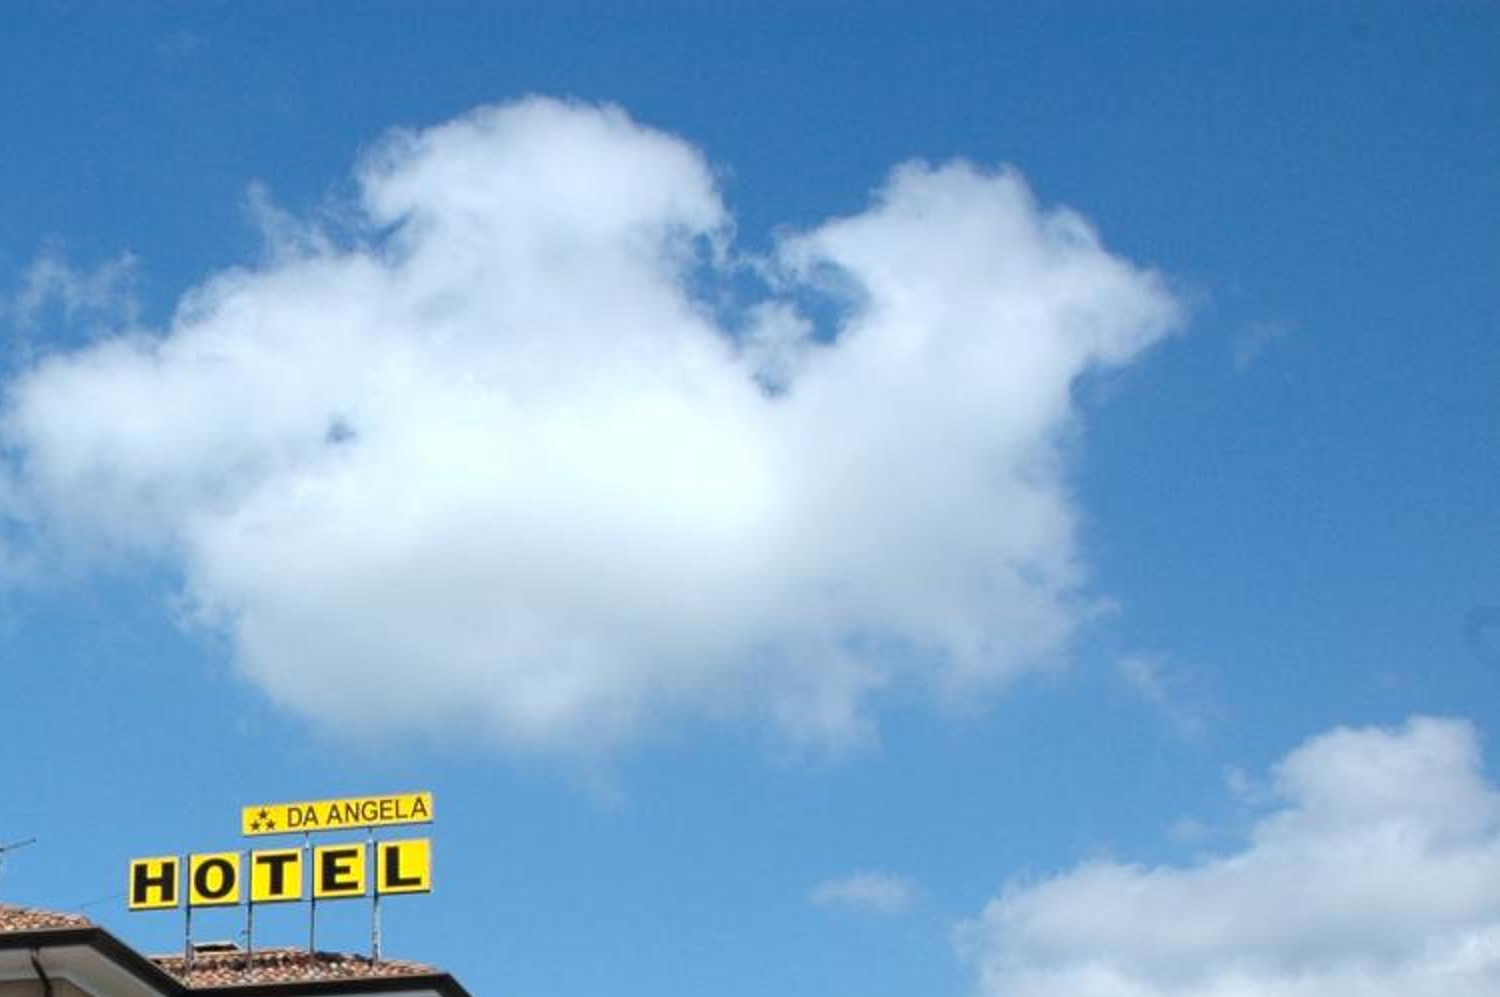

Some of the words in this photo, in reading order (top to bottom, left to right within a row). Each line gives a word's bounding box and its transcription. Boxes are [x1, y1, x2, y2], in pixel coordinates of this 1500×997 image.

[286, 805, 319, 829] DA
[325, 796, 428, 825] ANGELA
[132, 845, 422, 905] HOTEL
